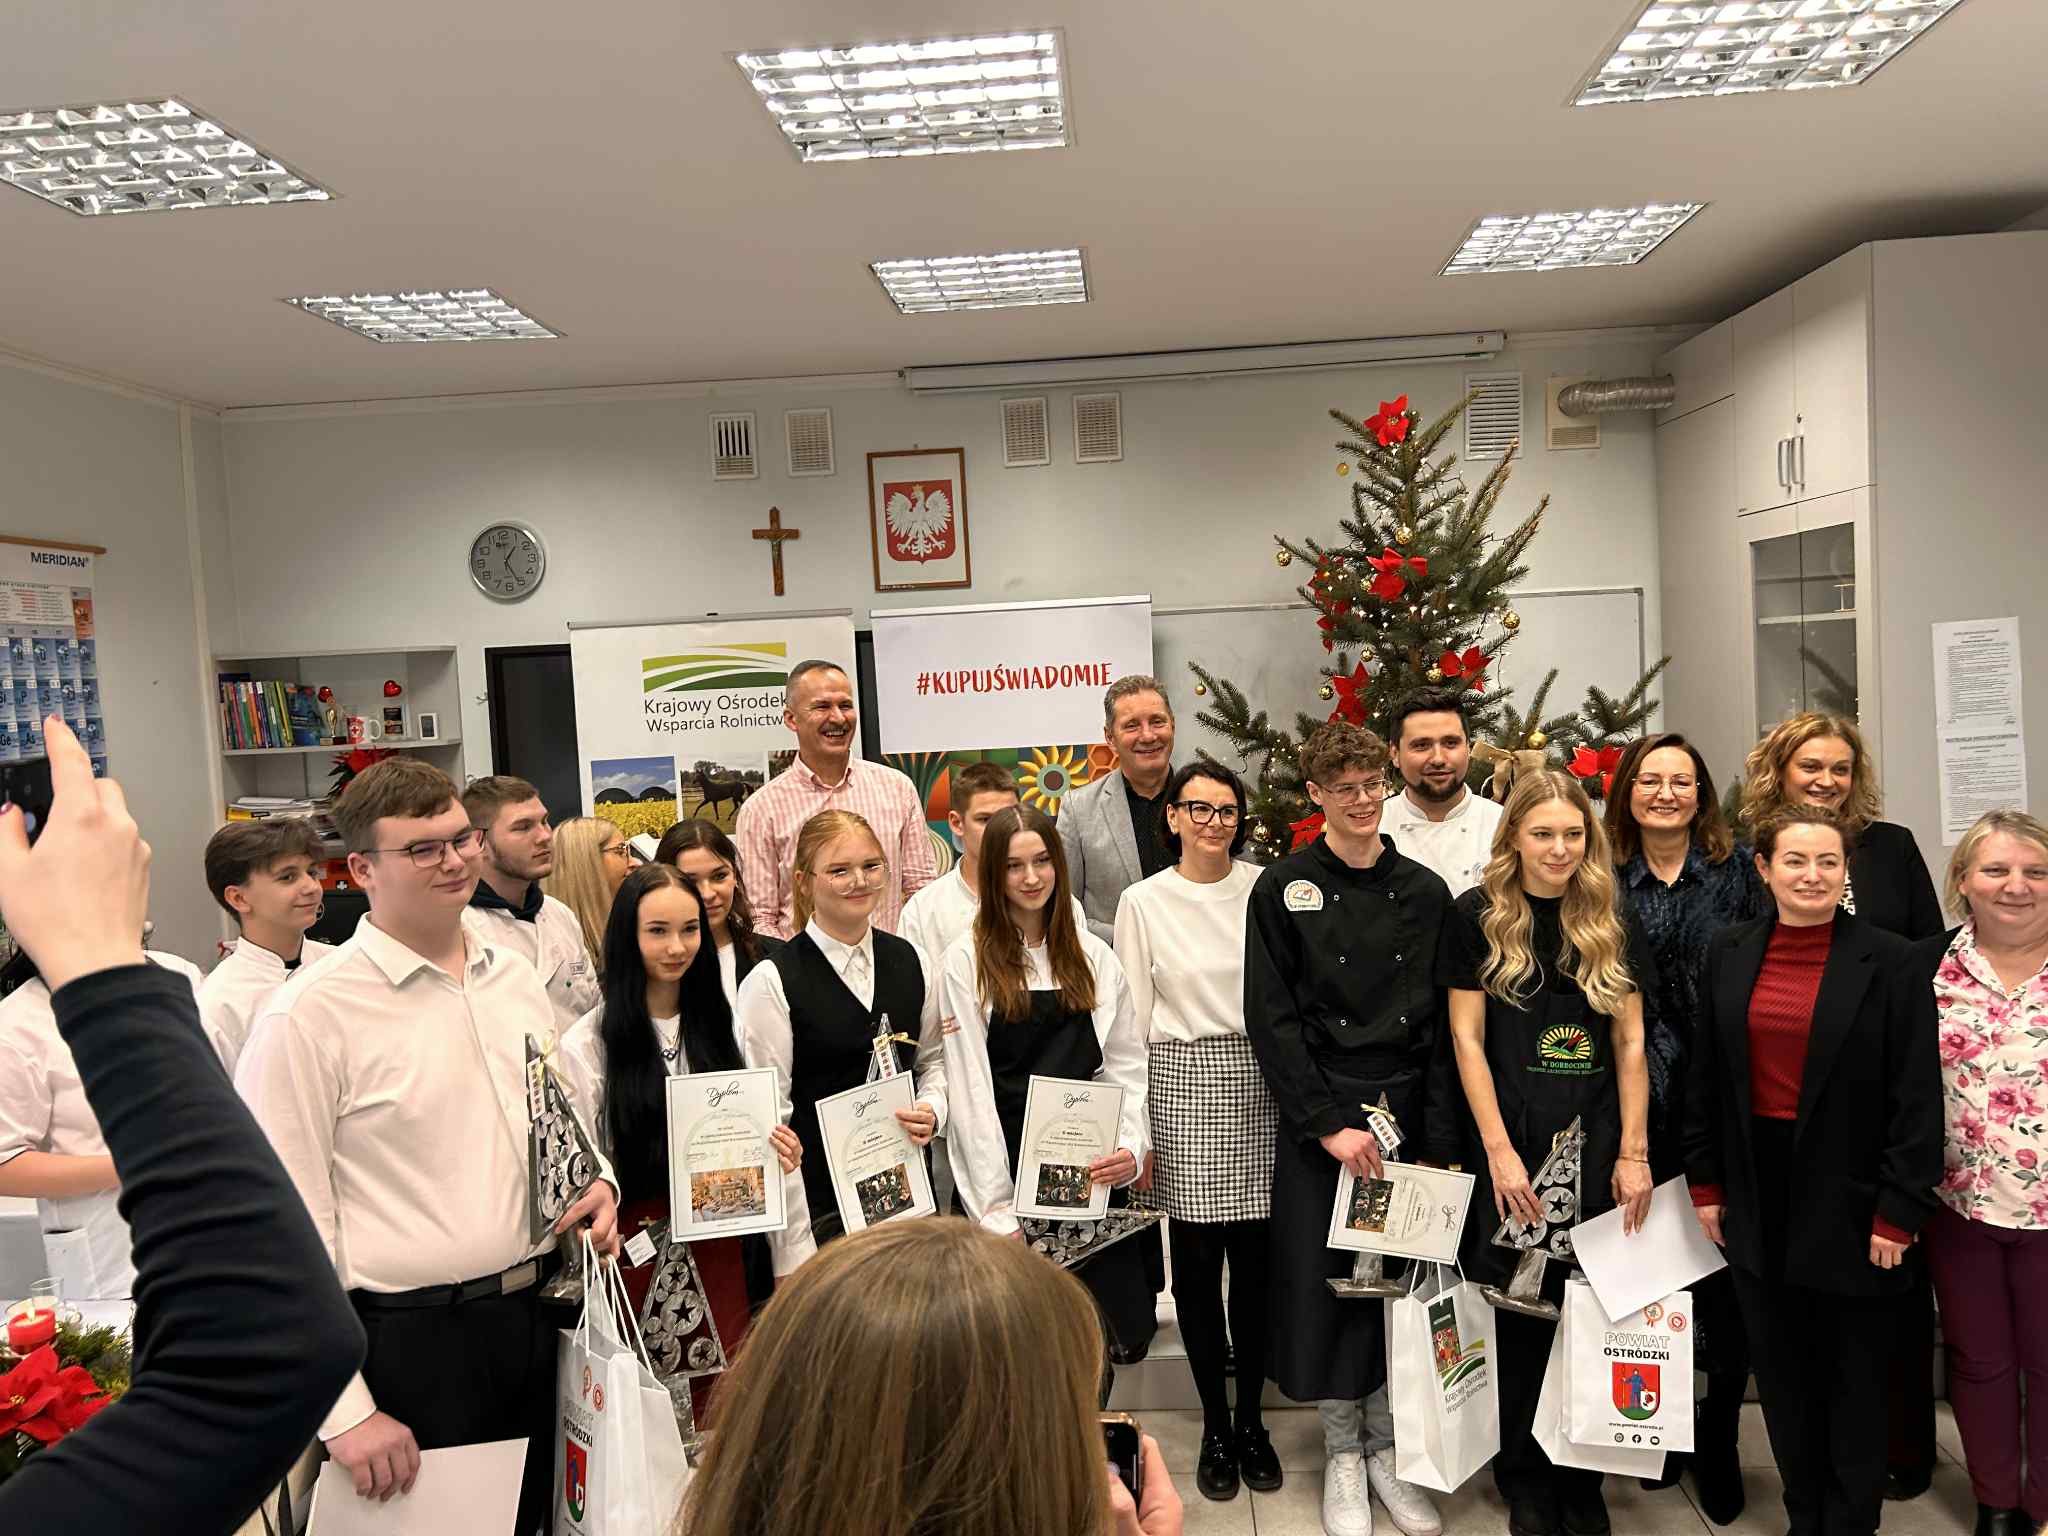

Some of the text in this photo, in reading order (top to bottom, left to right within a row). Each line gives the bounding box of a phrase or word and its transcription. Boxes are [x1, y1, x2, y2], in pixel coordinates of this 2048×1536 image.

[917, 663, 1113, 695] #KUPUJŚWIADOMIE
[644, 692, 787, 717] Krajowy Ośrodek
[646, 714, 784, 734] Wsparcia Rolnictw
[1604, 1331, 1670, 1349] POWIAT
[1603, 1346, 1670, 1360] OSTRÓDZKI
